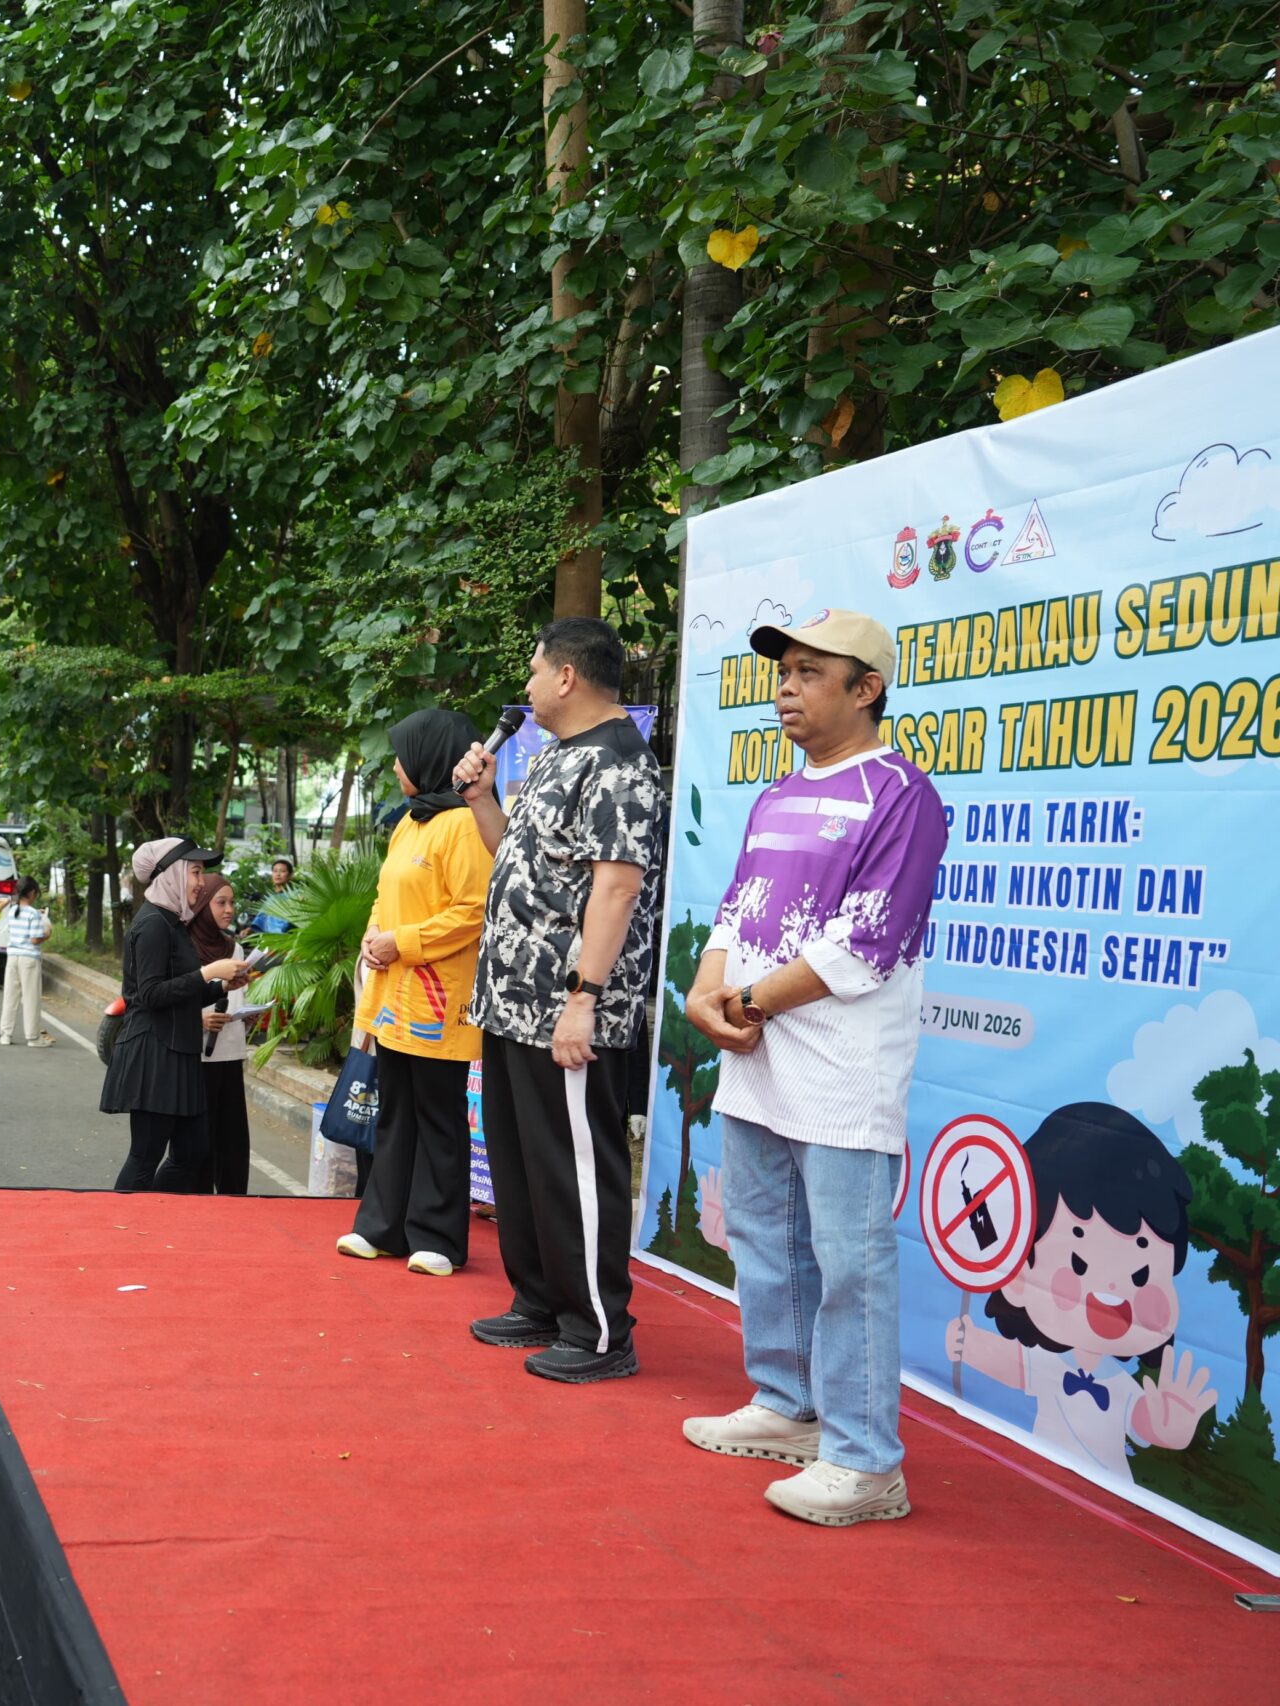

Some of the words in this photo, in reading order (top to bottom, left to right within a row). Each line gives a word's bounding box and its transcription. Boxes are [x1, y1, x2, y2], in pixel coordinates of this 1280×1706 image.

[897, 590, 1102, 688] TEMBAKAU
[999, 689, 1139, 773] TAHUN
[1148, 673, 1280, 765] 2026
[727, 727, 794, 785] KOTA
[965, 803, 1031, 843] DAYA
[1046, 800, 1141, 843] TARIK:
[1008, 865, 1122, 910] NIKOTIN
[1136, 868, 1203, 915] DAN
[946, 923, 1088, 975] INDONESIA
[932, 1006, 941, 1024] 7
[942, 1007, 979, 1030] JUNI
[983, 1013, 1021, 1037] 2026
[343, 1099, 379, 1117] APCAT
[470, 1186, 490, 1200] 2026
